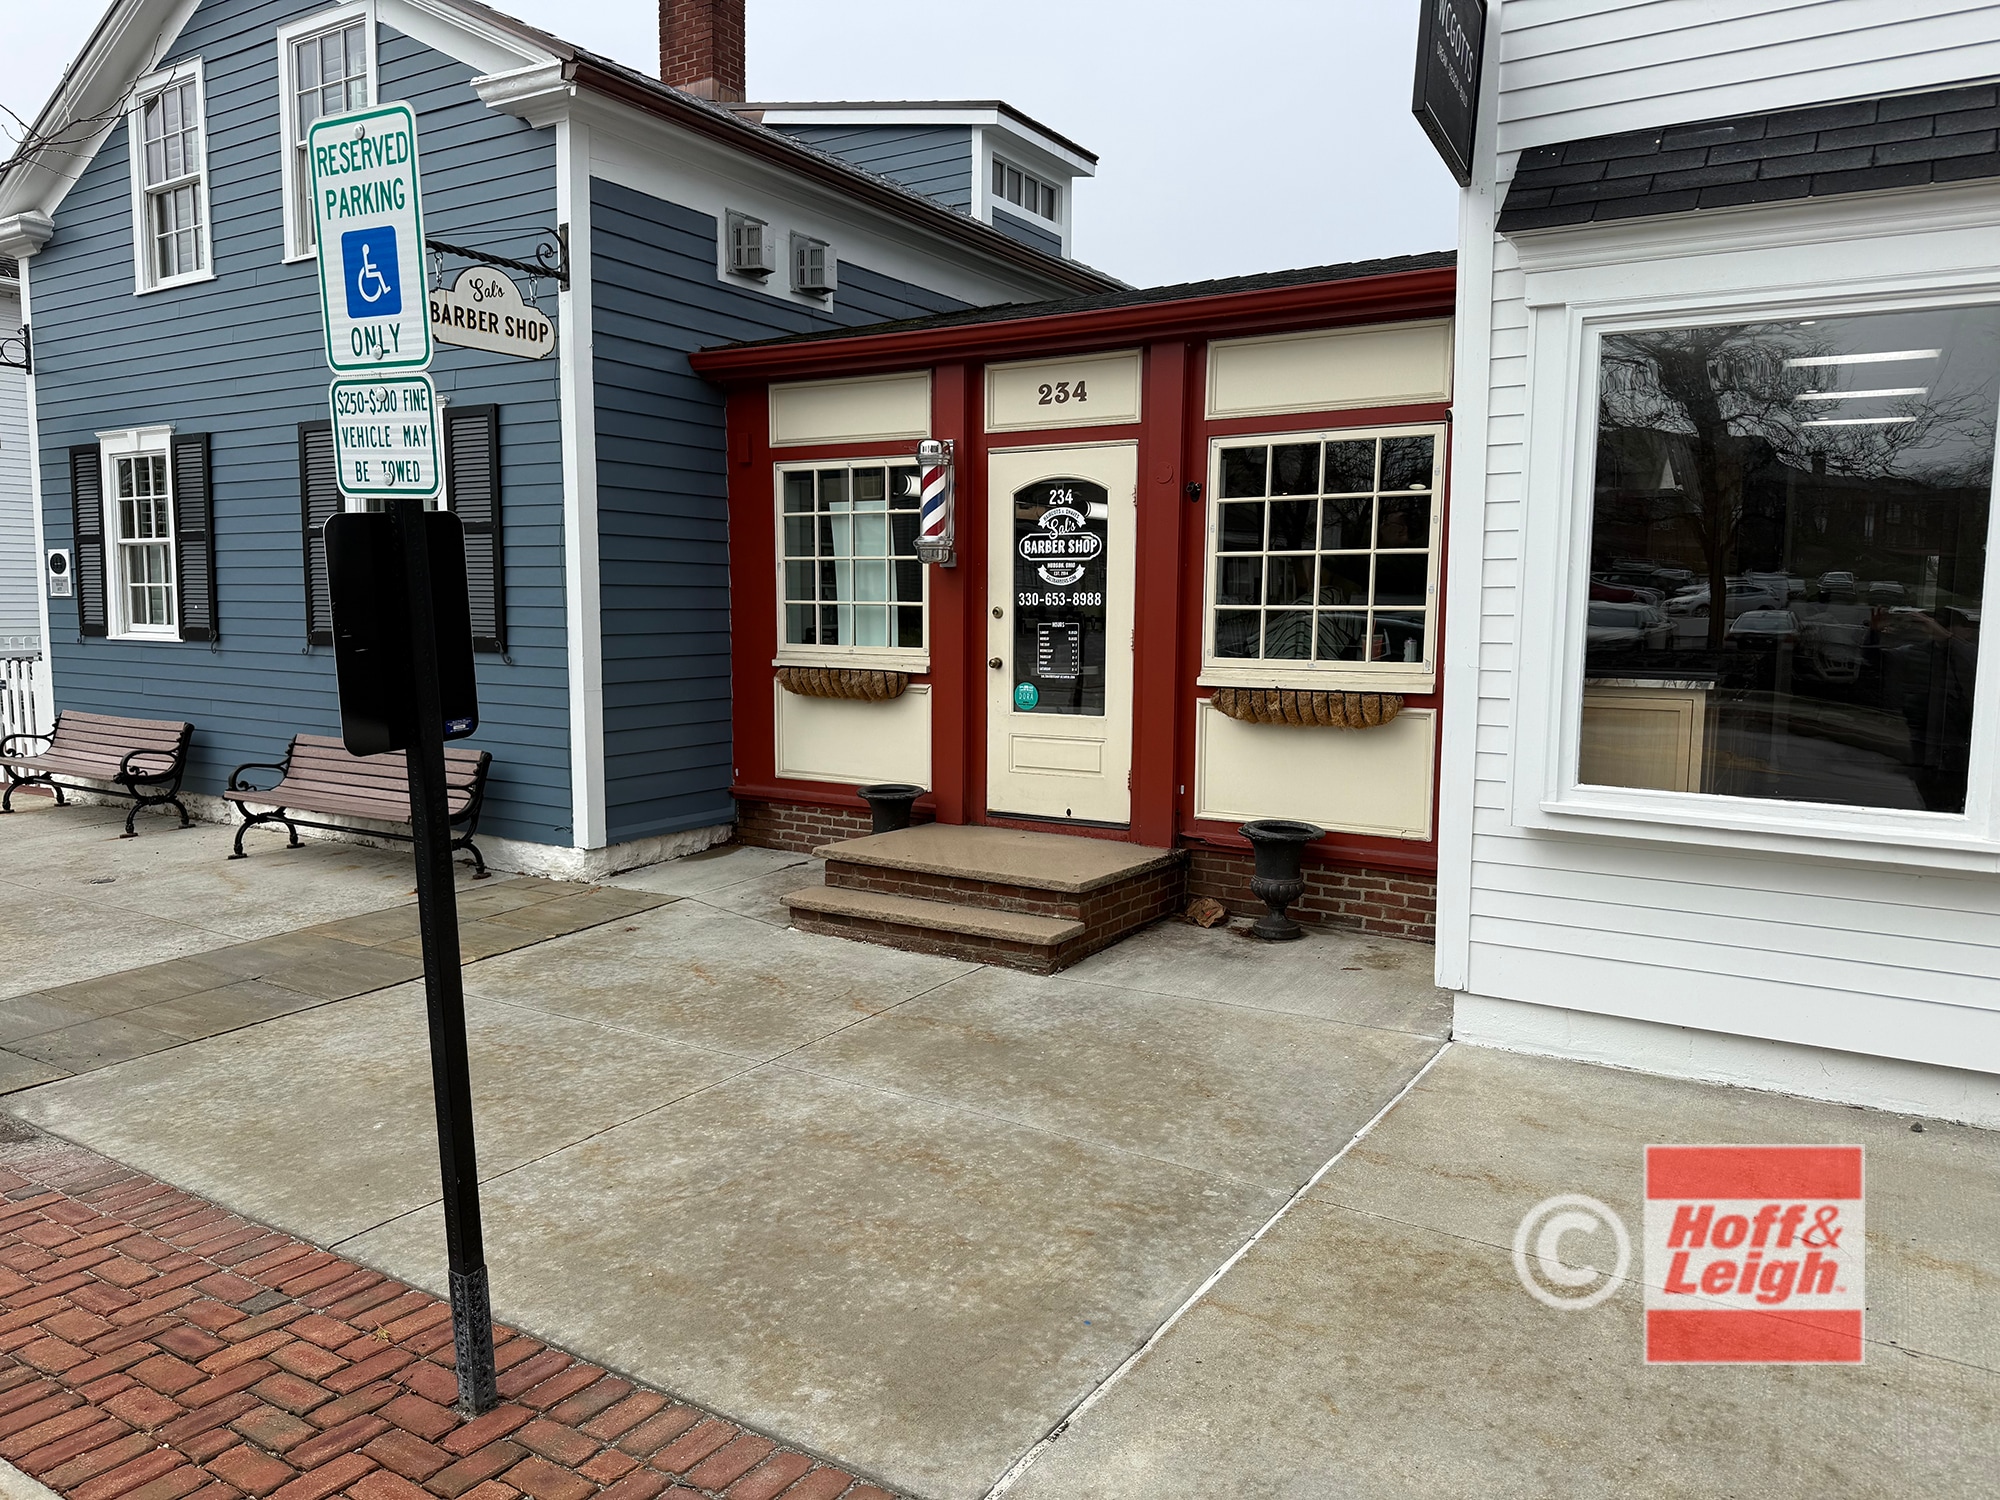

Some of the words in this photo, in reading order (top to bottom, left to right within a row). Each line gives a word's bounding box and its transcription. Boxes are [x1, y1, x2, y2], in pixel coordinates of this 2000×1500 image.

[316, 131, 409, 177] RESERVED
[325, 177, 406, 220] PARKING
[469, 278, 505, 302] Sal's
[430, 300, 499, 335] BARBER
[504, 315, 549, 343] SHOP
[351, 322, 401, 357] ONLY
[403, 389, 428, 411] FINE
[1038, 380, 1087, 405] 234
[342, 426, 392, 448] VEHICLE
[403, 425, 427, 447] MAY
[355, 461, 370, 482] BE
[381, 460, 420, 482] TOWED
[1049, 489, 1073, 505] 234
[1046, 517, 1076, 540] Sal's
[1024, 540, 1066, 554] BARBER
[1068, 539, 1098, 554] SHOP
[1018, 592, 1102, 606] 330-653-8988
